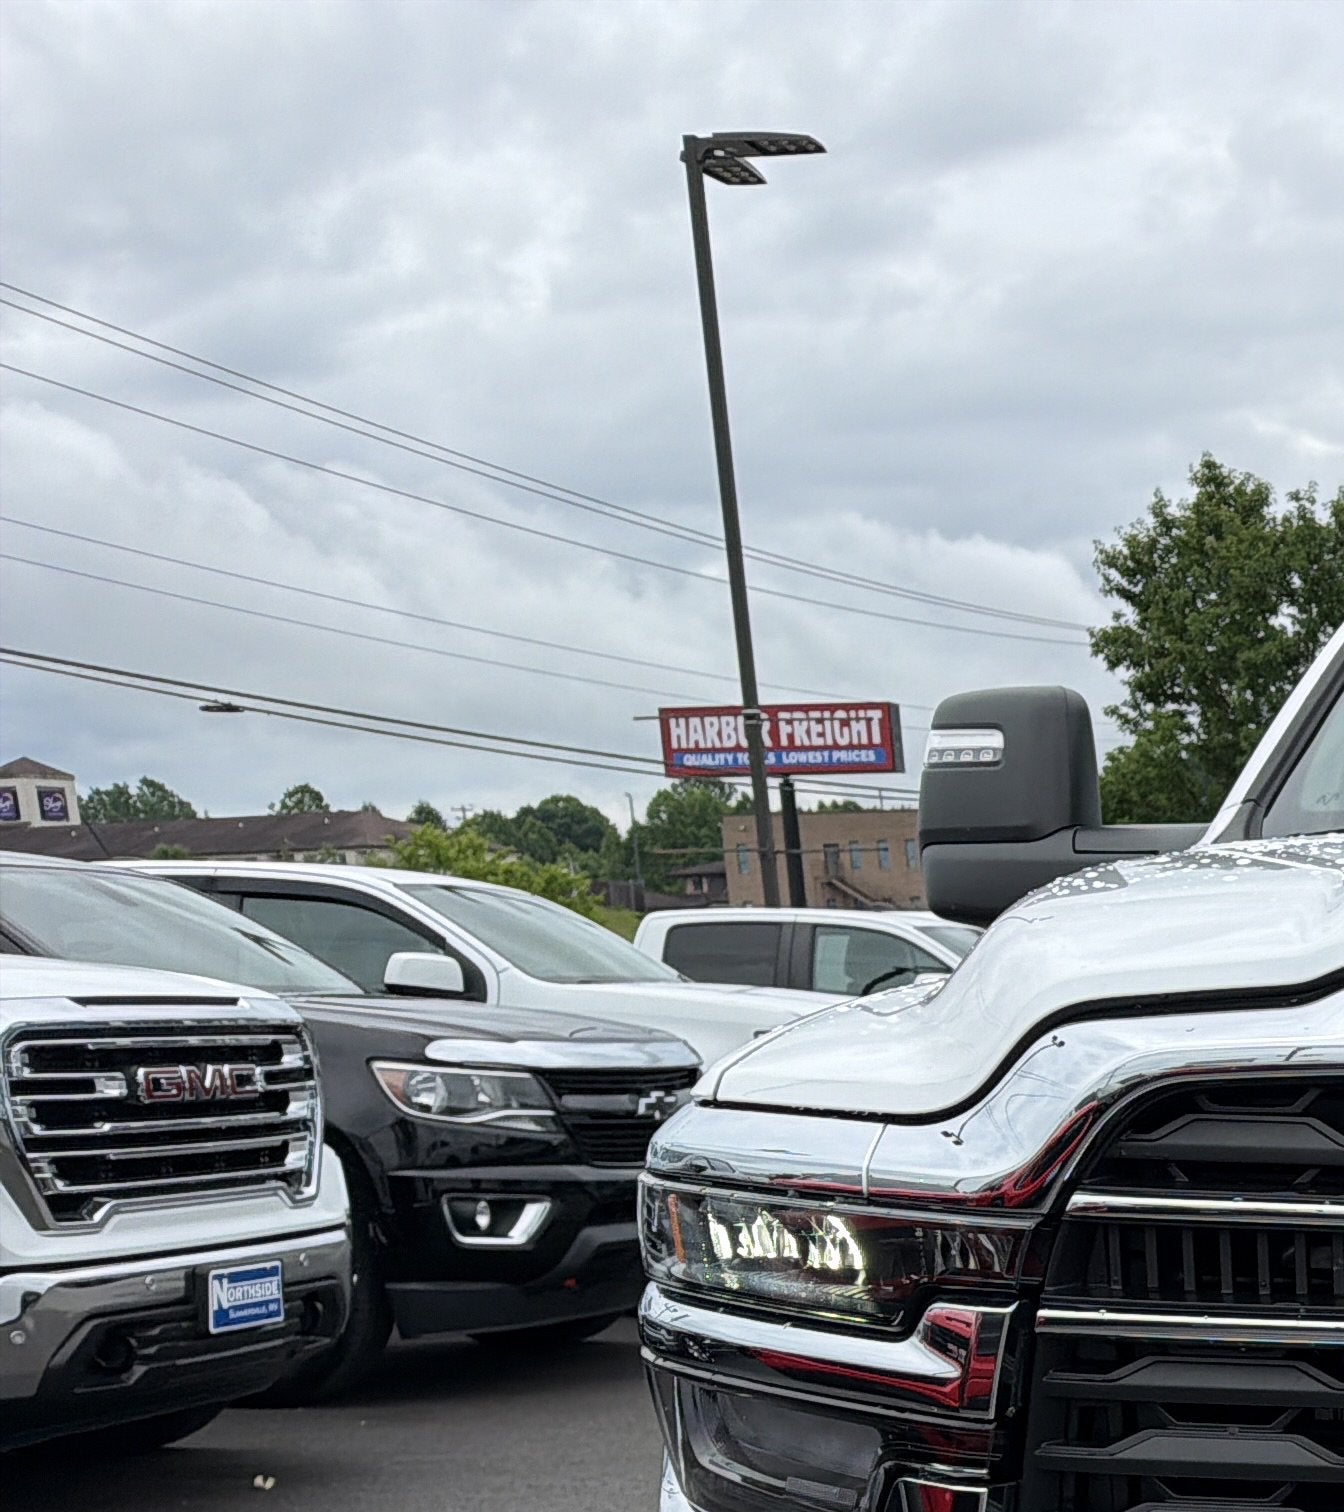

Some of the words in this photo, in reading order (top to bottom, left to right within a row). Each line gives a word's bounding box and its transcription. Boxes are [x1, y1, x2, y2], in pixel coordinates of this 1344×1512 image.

[777, 709, 883, 747] FREIGHT
[682, 752, 736, 766] QUALITY
[782, 750, 831, 764] LOWEST
[832, 749, 876, 763] PRICES
[137, 1064, 260, 1103] GMC
